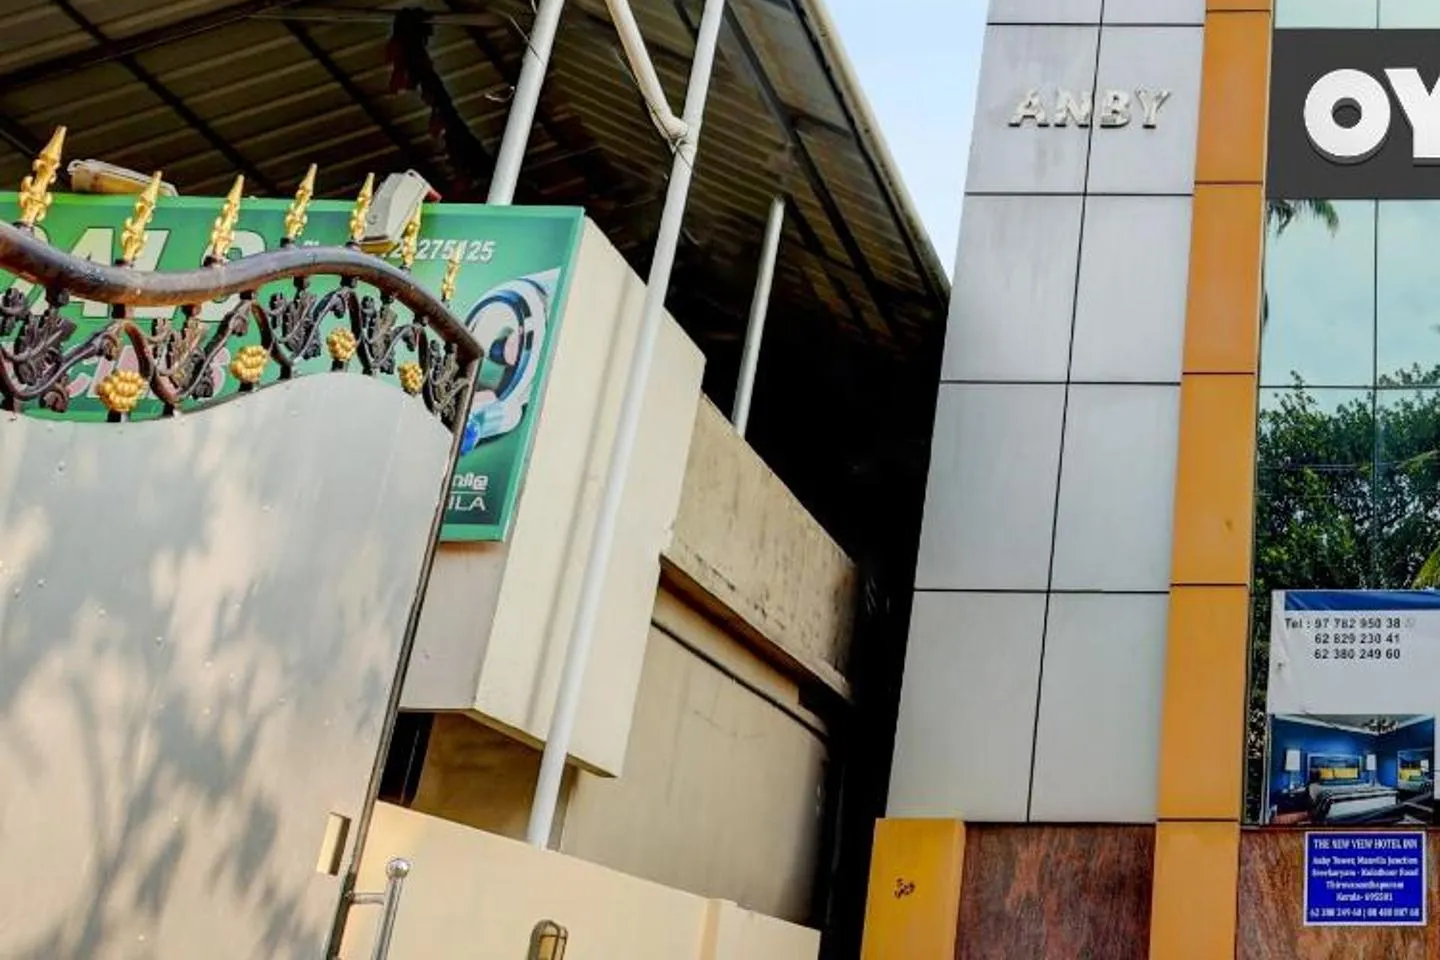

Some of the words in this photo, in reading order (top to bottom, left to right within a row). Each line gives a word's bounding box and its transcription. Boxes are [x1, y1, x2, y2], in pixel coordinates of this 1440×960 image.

[1008, 86, 1171, 129] ANBY
[449, 495, 486, 511] ILA
[1314, 633, 1330, 644] 62
[1385, 633, 1400, 643] 41
[1314, 648, 1329, 659] 62
[1360, 648, 1381, 659] 249
[1385, 648, 1400, 659] 60
